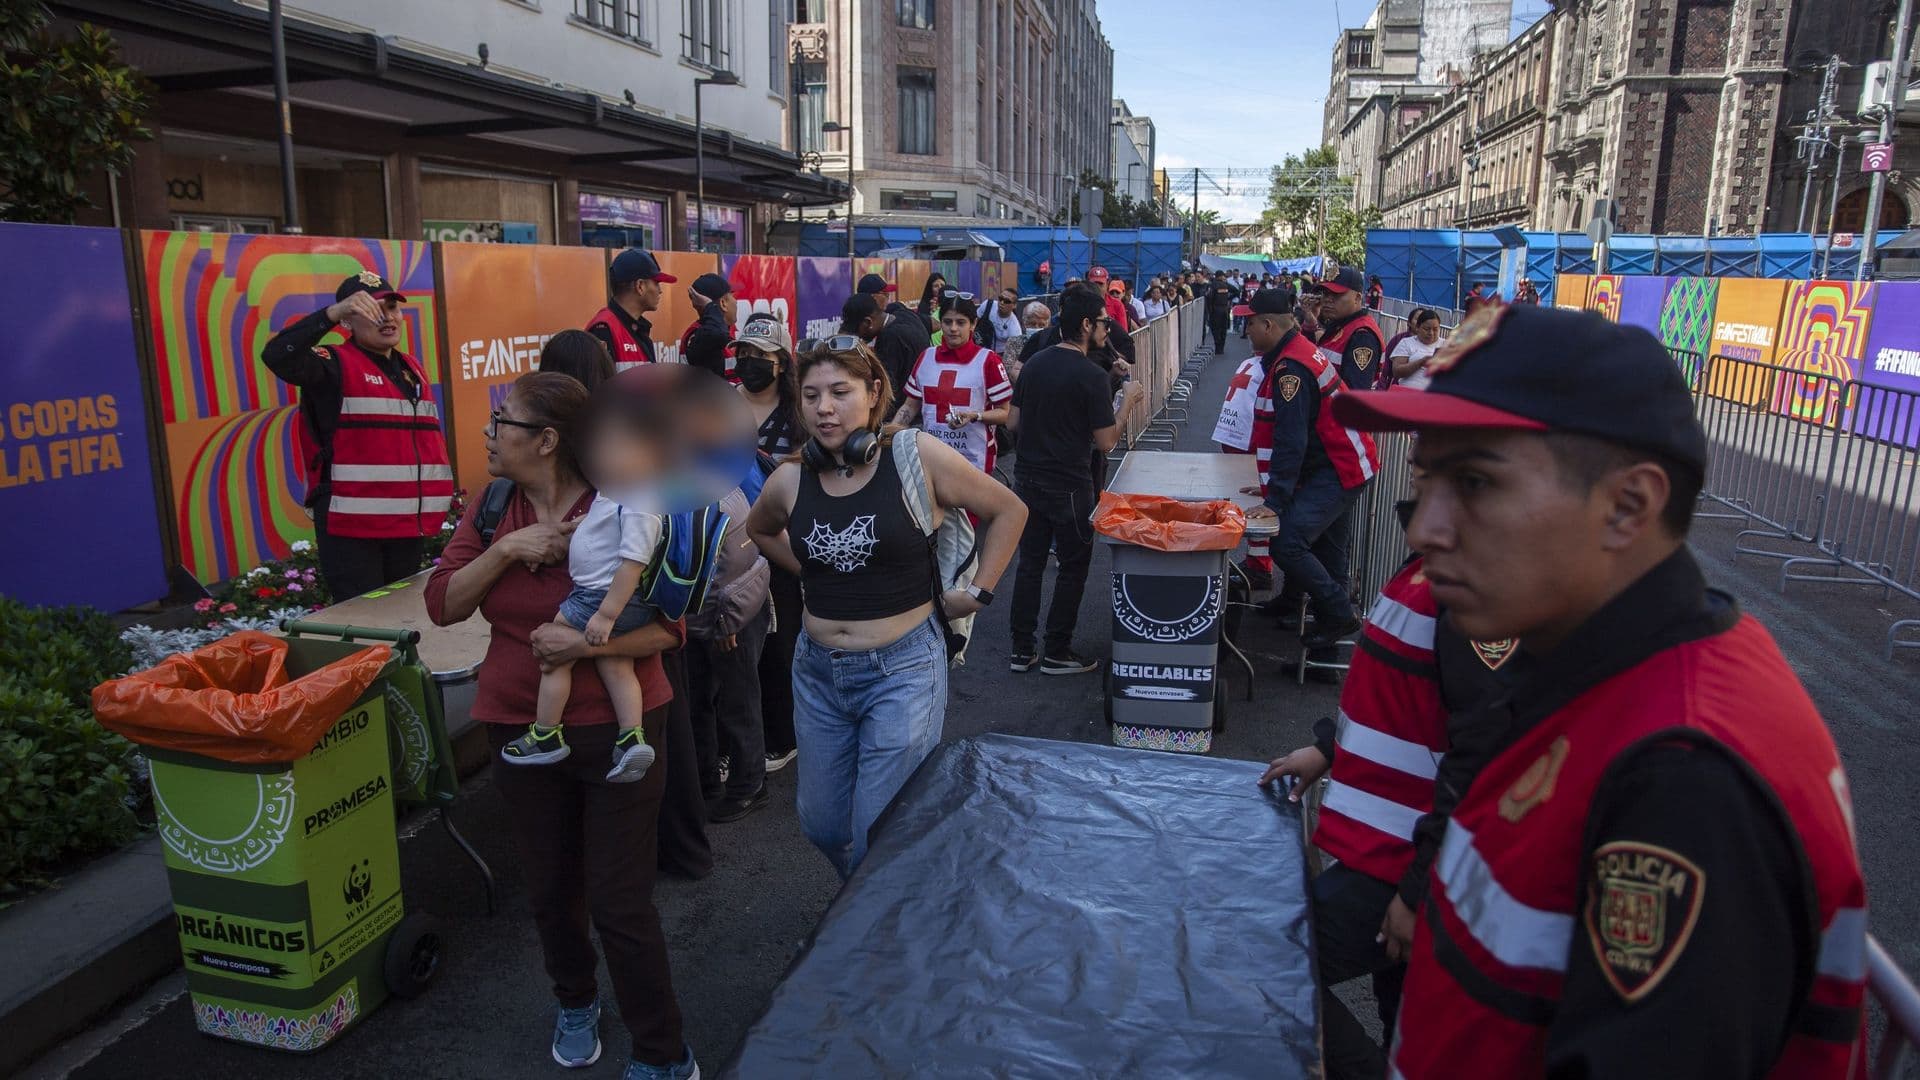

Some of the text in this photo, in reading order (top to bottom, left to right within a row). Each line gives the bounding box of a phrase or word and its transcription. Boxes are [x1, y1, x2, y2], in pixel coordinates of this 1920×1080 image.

[9, 393, 118, 440] COPAS
[943, 431, 968, 440] ROJA
[0, 433, 124, 489] LA FIFA
[1112, 662, 1212, 681] RECICLABLES
[304, 775, 387, 835] PROMESA
[346, 899, 371, 921] WWF
[203, 955, 271, 975] Nueva composta
